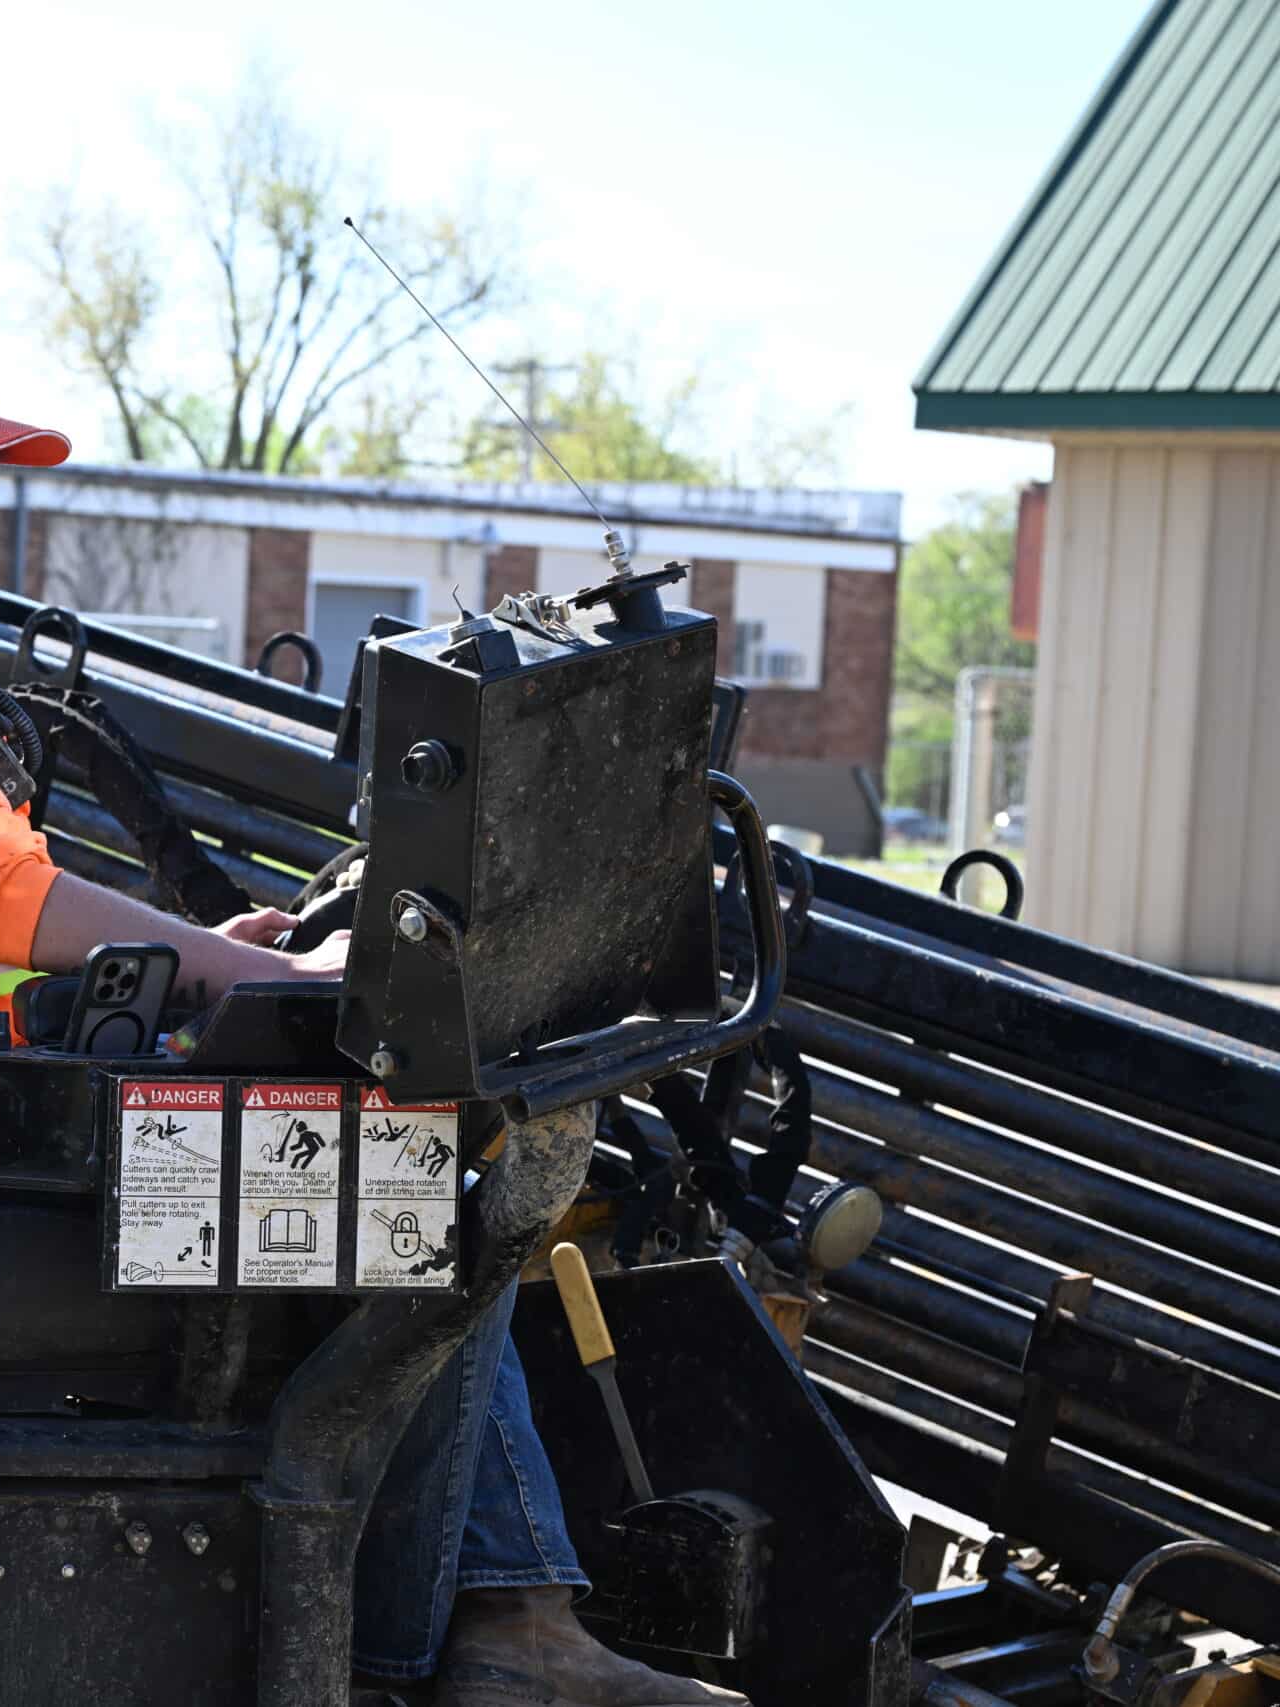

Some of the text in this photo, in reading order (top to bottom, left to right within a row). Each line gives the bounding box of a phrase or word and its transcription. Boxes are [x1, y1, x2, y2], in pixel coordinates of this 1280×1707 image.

[151, 1089, 221, 1104] DANGER
[269, 1091, 340, 1106] DANGER
[122, 1164, 151, 1173] Cutters
[169, 1165, 197, 1175] quickly
[242, 1169, 273, 1178] Wrench
[286, 1170, 317, 1179] rotating
[317, 1171, 331, 1179] rod
[122, 1175, 159, 1185] sideways
[160, 1175, 176, 1183] and
[177, 1175, 199, 1183] catch
[302, 1178, 326, 1187] Death
[365, 1178, 448, 1188] Unexpected rotation
[121, 1184, 146, 1193] Death
[391, 1188, 415, 1197] string
[121, 1199, 137, 1208] Pull
[138, 1200, 167, 1209] cutters
[168, 1201, 179, 1210] up
[180, 1200, 190, 1208] to
[121, 1208, 139, 1217] hole
[140, 1208, 167, 1217] before
[121, 1218, 139, 1229] Stay
[244, 1258, 260, 1267] See
[243, 1266, 255, 1275] for
[256, 1267, 281, 1277] proper
[283, 1268, 298, 1276] use
